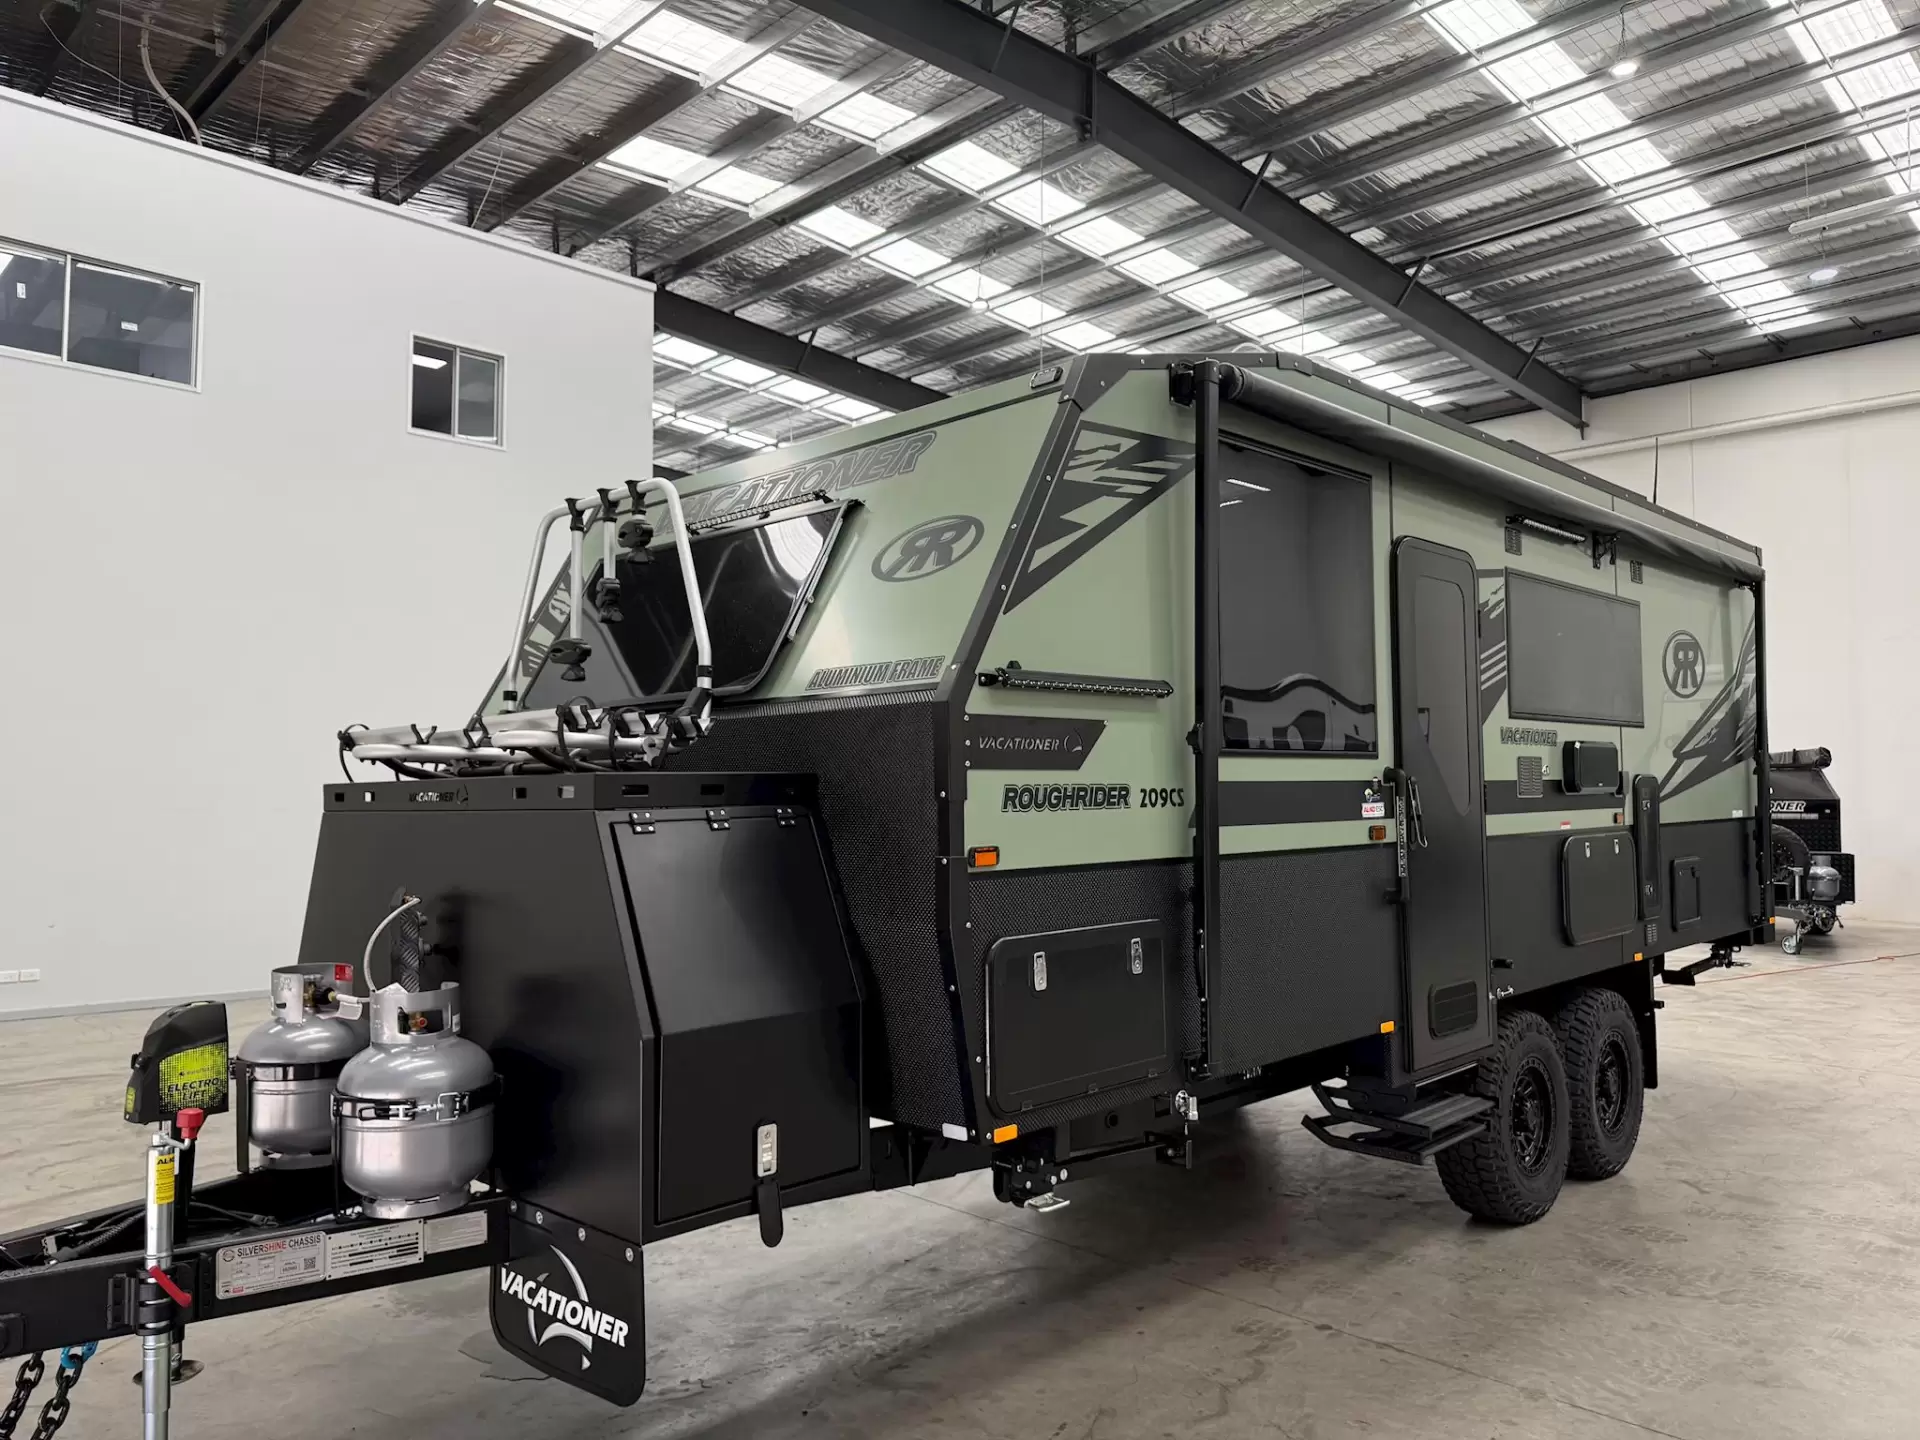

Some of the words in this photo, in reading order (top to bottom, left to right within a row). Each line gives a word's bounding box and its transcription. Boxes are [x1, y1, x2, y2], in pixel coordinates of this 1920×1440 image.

[805, 660, 893, 691] ALUMINIUM
[886, 655, 946, 683] FRAME
[978, 736, 1060, 751] VACATIONER
[1500, 726, 1557, 747] VACATIONER
[1001, 783, 1131, 812] ROUGHRIDER
[1139, 788, 1185, 808] 209CS
[168, 1077, 219, 1093] ELECTRO
[183, 1089, 206, 1101] LIFT
[237, 1240, 287, 1257] SILVERSHINE
[288, 1234, 321, 1249] CHASSIS
[500, 1266, 629, 1348] VACATIONER
